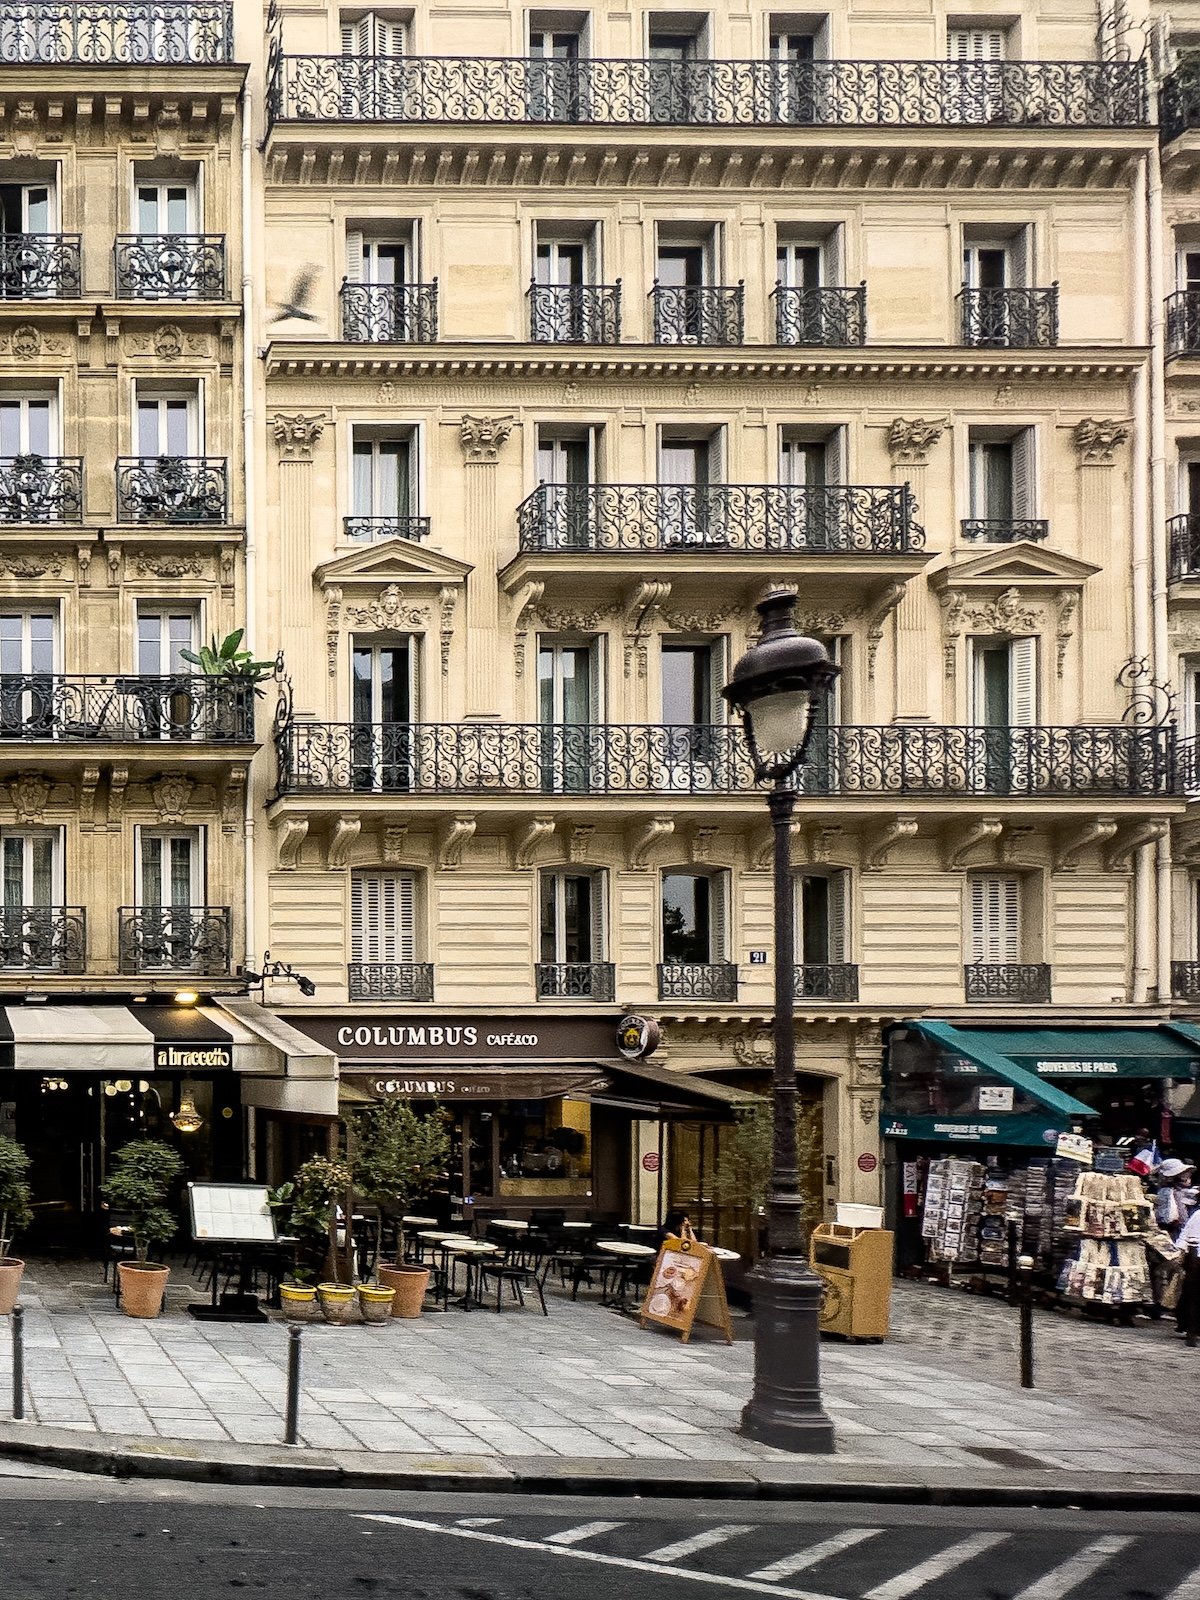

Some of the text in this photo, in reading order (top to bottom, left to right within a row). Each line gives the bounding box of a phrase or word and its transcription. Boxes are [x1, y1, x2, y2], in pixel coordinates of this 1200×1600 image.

[752, 952, 765, 963] 21
[337, 1026, 539, 1046] COLUMBUS CAFÉ&CO
[158, 1047, 230, 1066] a braccetto
[1036, 1062, 1118, 1073] SOUVENIRS DE PARIS
[375, 1081, 456, 1093] COLUMBUS
